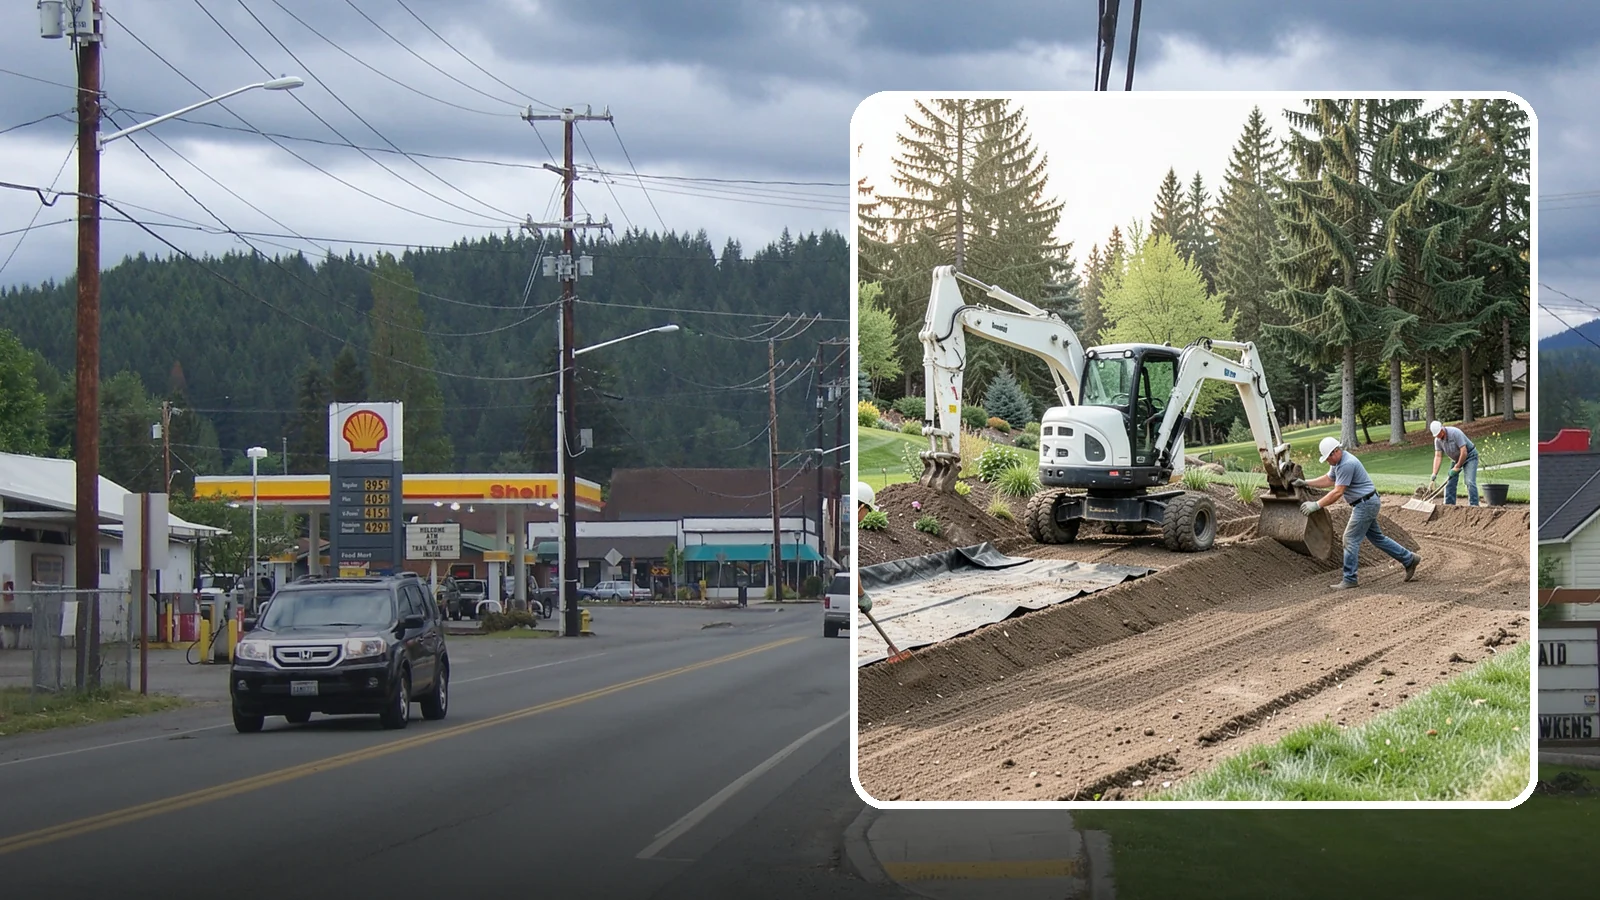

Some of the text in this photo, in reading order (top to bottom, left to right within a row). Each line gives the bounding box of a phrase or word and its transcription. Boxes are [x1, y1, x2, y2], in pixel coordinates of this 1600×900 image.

[366, 480, 384, 490] 395
[490, 484, 547, 499] Shell
[366, 494, 384, 504] 405
[366, 508, 384, 518] 415
[366, 522, 384, 532] 429
